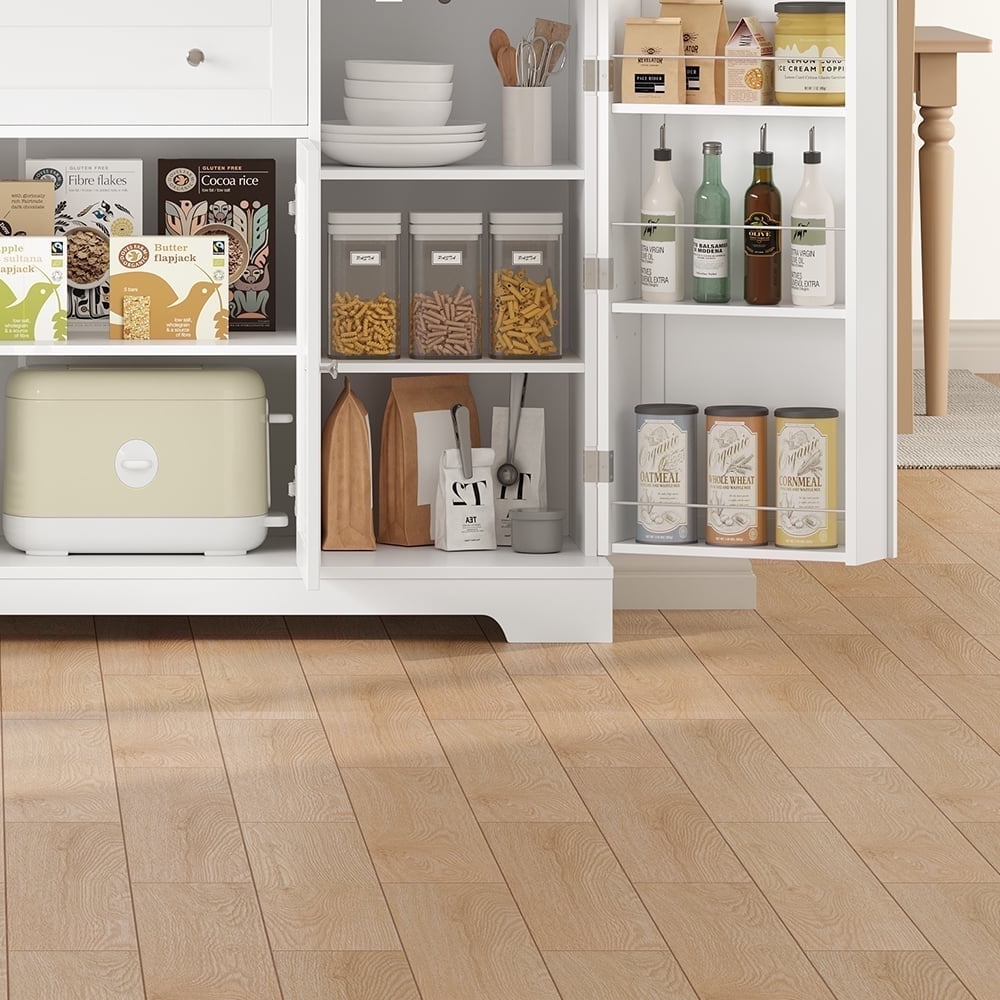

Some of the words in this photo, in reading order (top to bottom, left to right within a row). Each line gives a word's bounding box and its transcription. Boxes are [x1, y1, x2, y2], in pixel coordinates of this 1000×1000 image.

[68, 174, 94, 185] Fibre
[97, 174, 127, 185] flakes
[201, 175, 236, 186] Cocoa
[239, 175, 259, 186] rice
[154, 244, 188, 252] Butter
[154, 254, 196, 263] flapjack
[639, 433, 680, 467] Organic
[709, 434, 749, 469] Organic
[779, 437, 819, 473] Organic
[640, 472, 680, 483] OATMEAL
[709, 475, 728, 484] WHOLE
[729, 476, 754, 485] WHEAT
[780, 477, 822, 487] CORNMEAL
